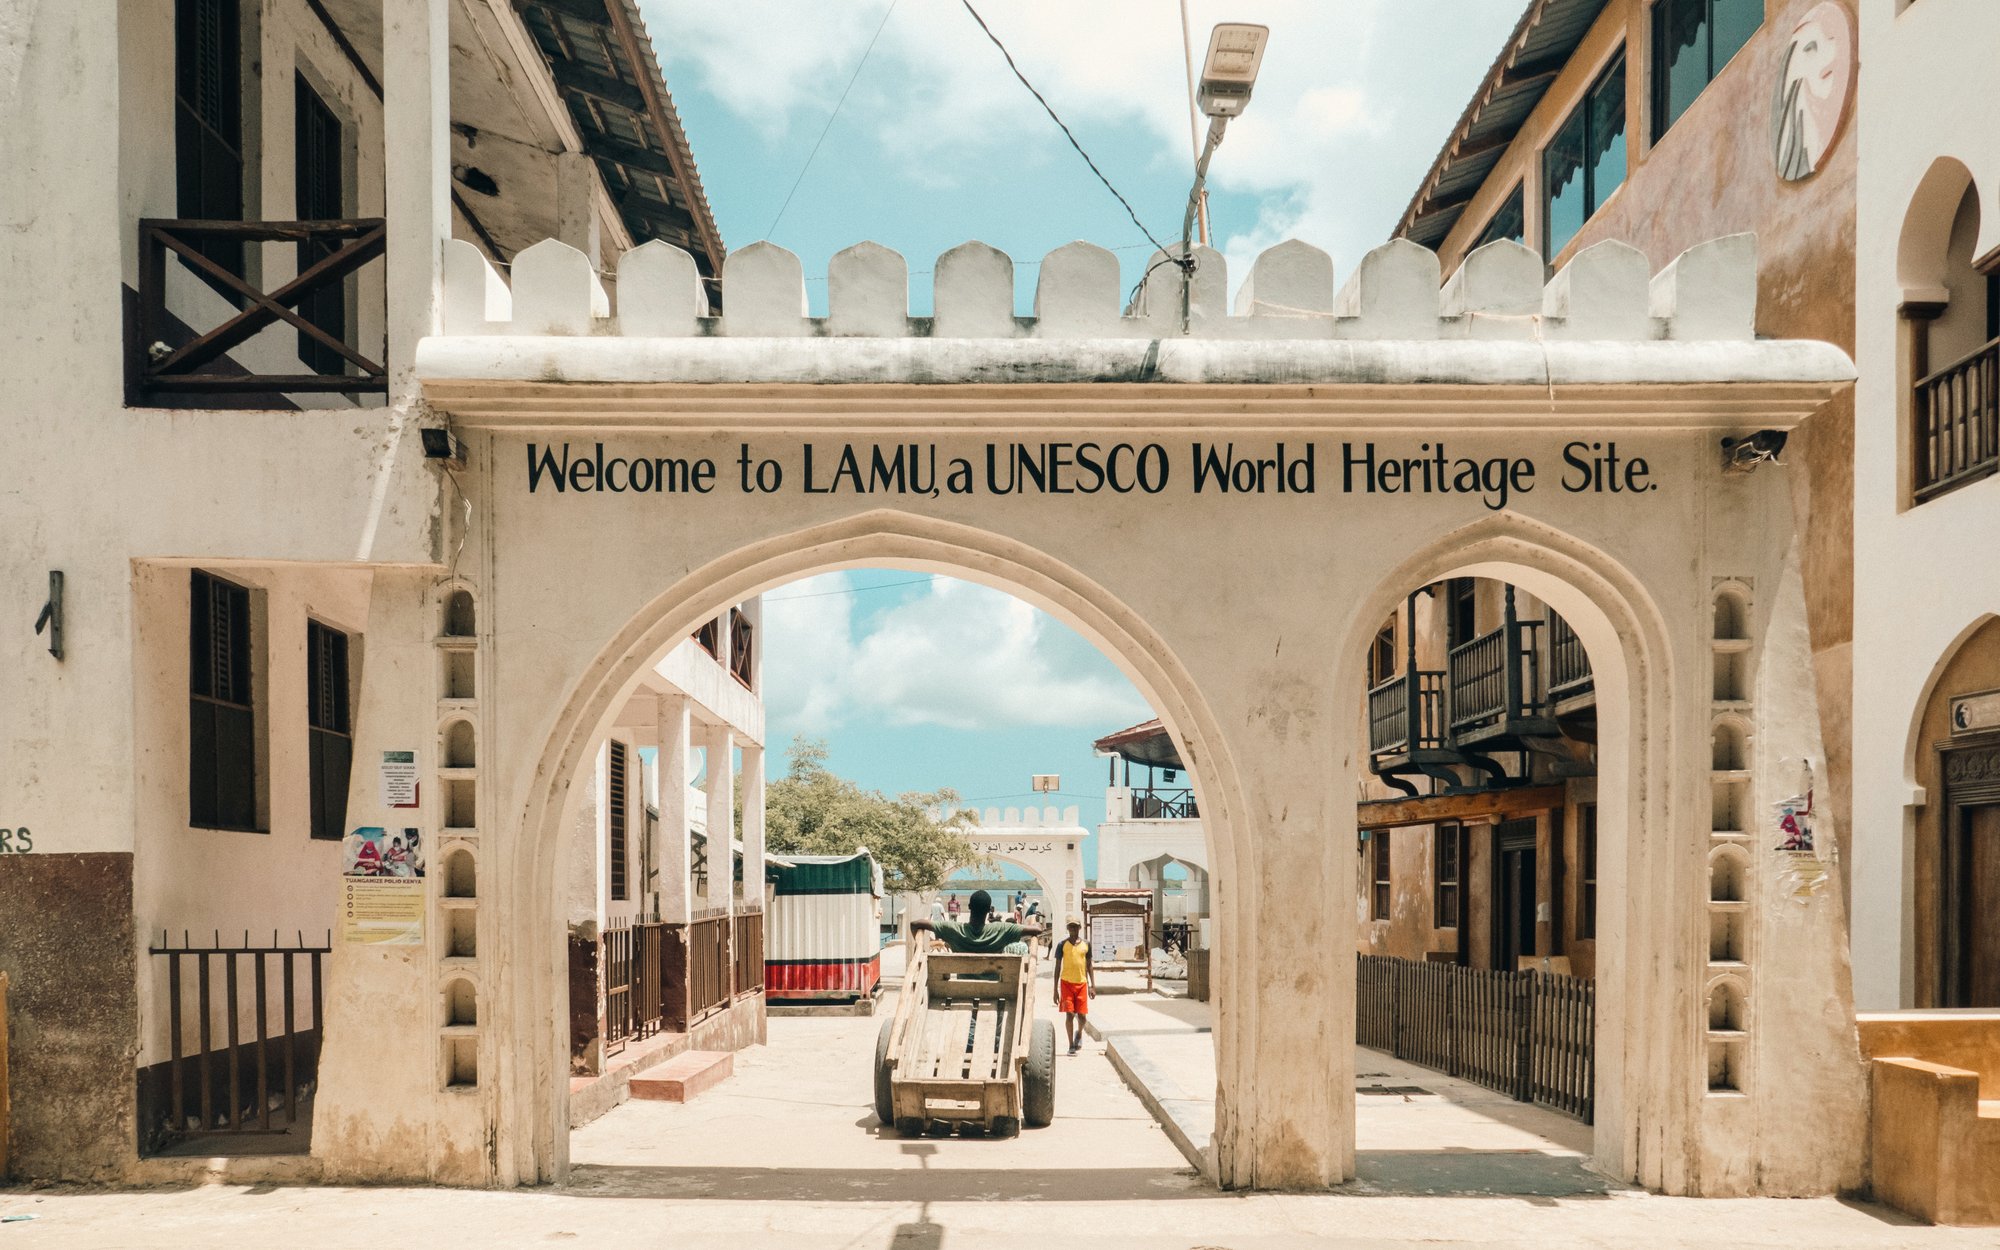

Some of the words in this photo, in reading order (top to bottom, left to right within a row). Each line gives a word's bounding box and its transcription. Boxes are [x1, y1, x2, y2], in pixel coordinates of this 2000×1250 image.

[526, 443, 715, 493] Welcome
[736, 443, 782, 493] to
[803, 443, 939, 498] LAMU,
[946, 458, 973, 493] a
[986, 443, 1169, 493] UNESCO
[1191, 442, 1314, 493] World
[1342, 442, 1535, 510] Heritage
[1561, 441, 1657, 493] Site.
[0, 827, 33, 853] RS
